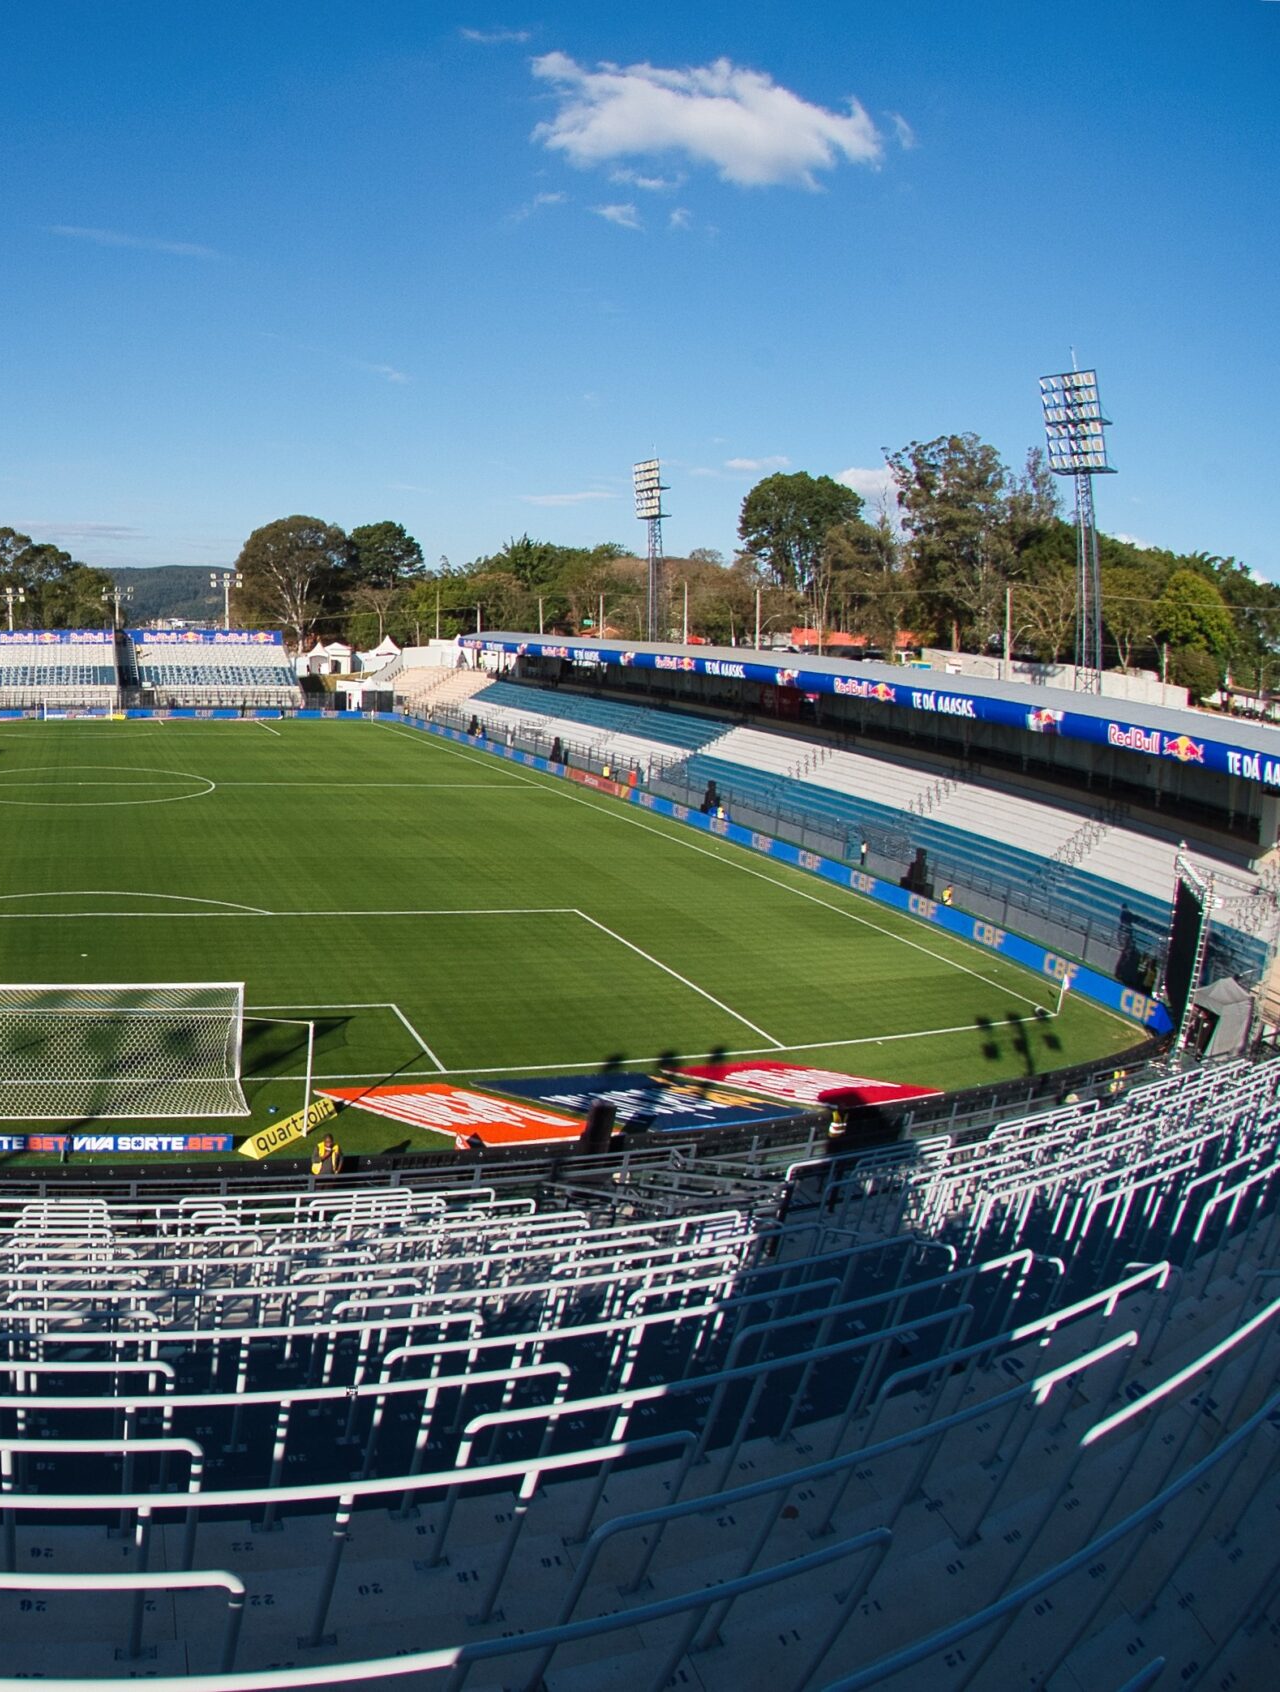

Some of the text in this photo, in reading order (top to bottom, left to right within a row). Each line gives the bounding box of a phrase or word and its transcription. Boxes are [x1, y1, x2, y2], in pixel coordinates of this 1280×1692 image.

[912, 692, 922, 709] TE
[922, 690, 936, 712] DÁ
[1226, 750, 1241, 776] TE
[1242, 752, 1260, 781] DÁ
[798, 850, 822, 870] CBF
[850, 870, 876, 894] CBF
[908, 894, 938, 920] CBF
[972, 920, 1008, 950] CBF
[1043, 950, 1080, 980] CBF
[1120, 988, 1159, 1026] CBF
[798, 1488, 816, 1502] 10
[494, 1511, 514, 1524] 16
[416, 1524, 437, 1537] 18
[30, 1546, 55, 1559] 26
[230, 1542, 254, 1553] 22
[540, 1556, 562, 1570] 16
[946, 1559, 966, 1576] 10
[1088, 1562, 1108, 1580] 08
[456, 1570, 480, 1584] 18
[357, 1582, 384, 1597] 20
[19, 1599, 46, 1613] 26
[248, 1594, 276, 1608] 22
[860, 1599, 883, 1616] 12
[1033, 1598, 1054, 1617] 10
[1126, 1636, 1146, 1658] 10
[944, 1648, 966, 1668] 12
